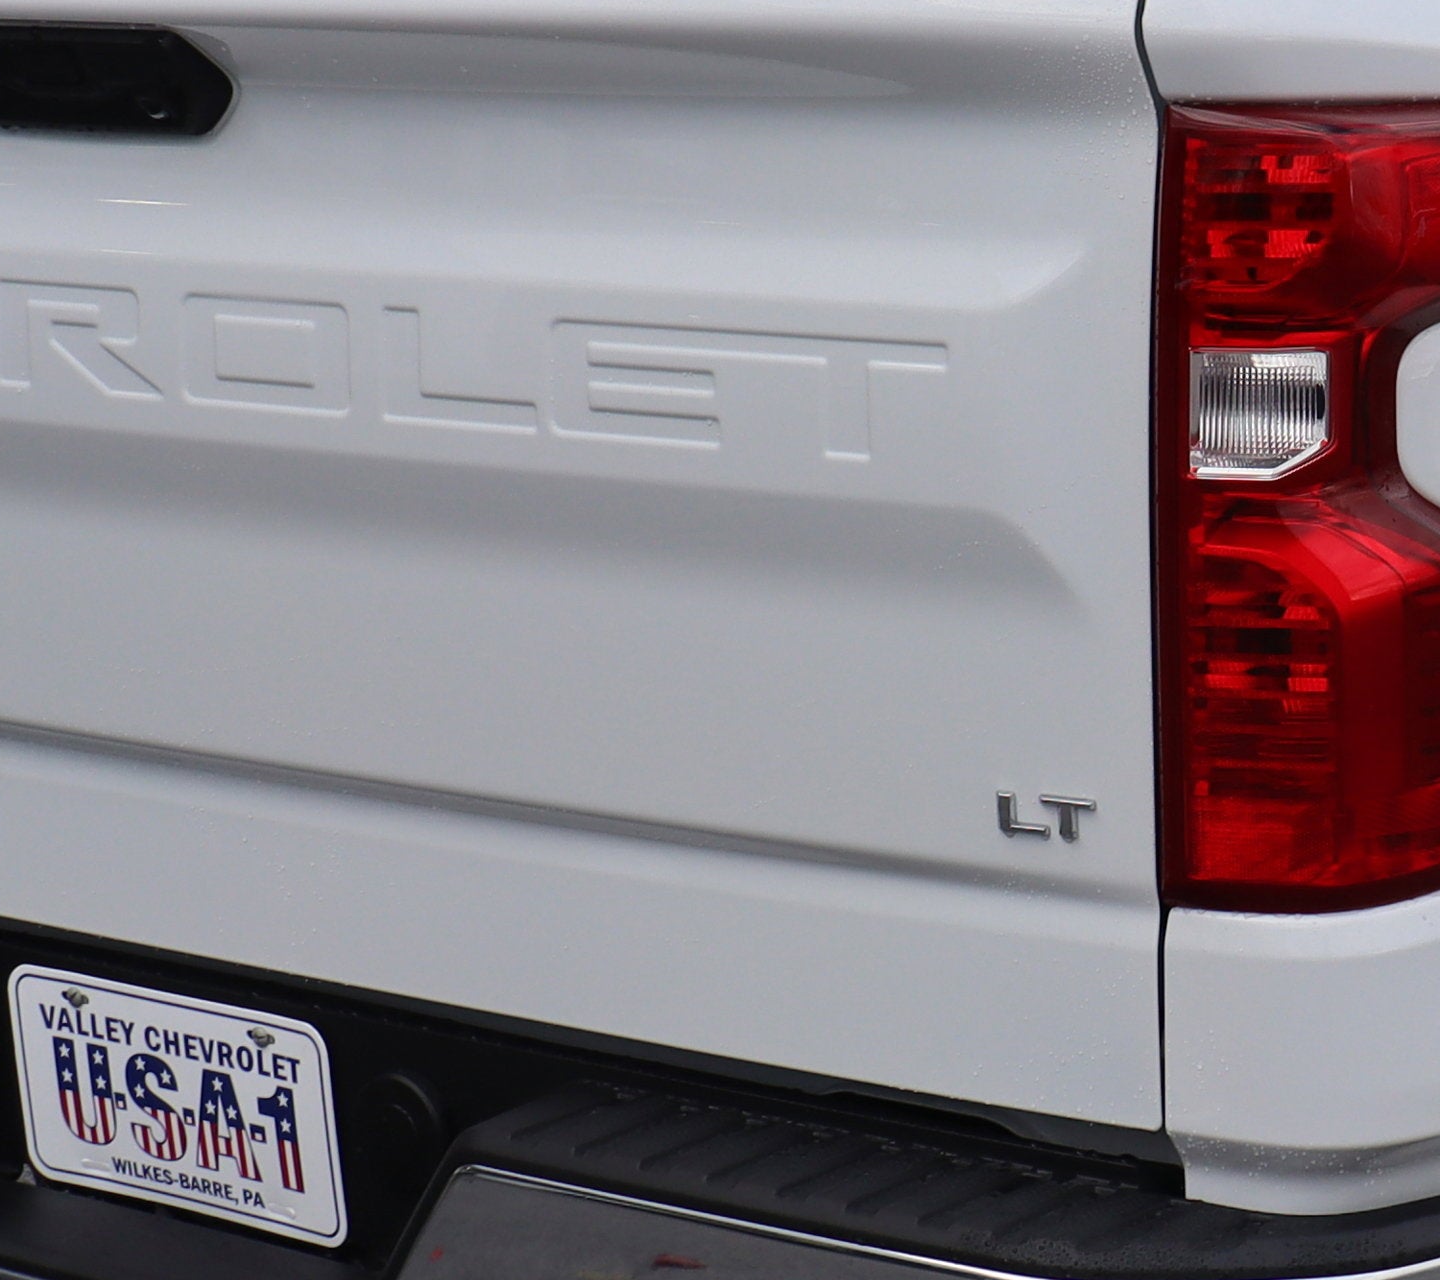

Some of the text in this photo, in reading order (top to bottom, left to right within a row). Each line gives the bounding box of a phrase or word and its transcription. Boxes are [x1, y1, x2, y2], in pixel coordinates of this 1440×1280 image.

[996, 790, 1097, 843] LT
[39, 1003, 300, 1084] VALLEY CHEVROLET
[111, 1157, 266, 1208] WILKES-BARRE, PA
